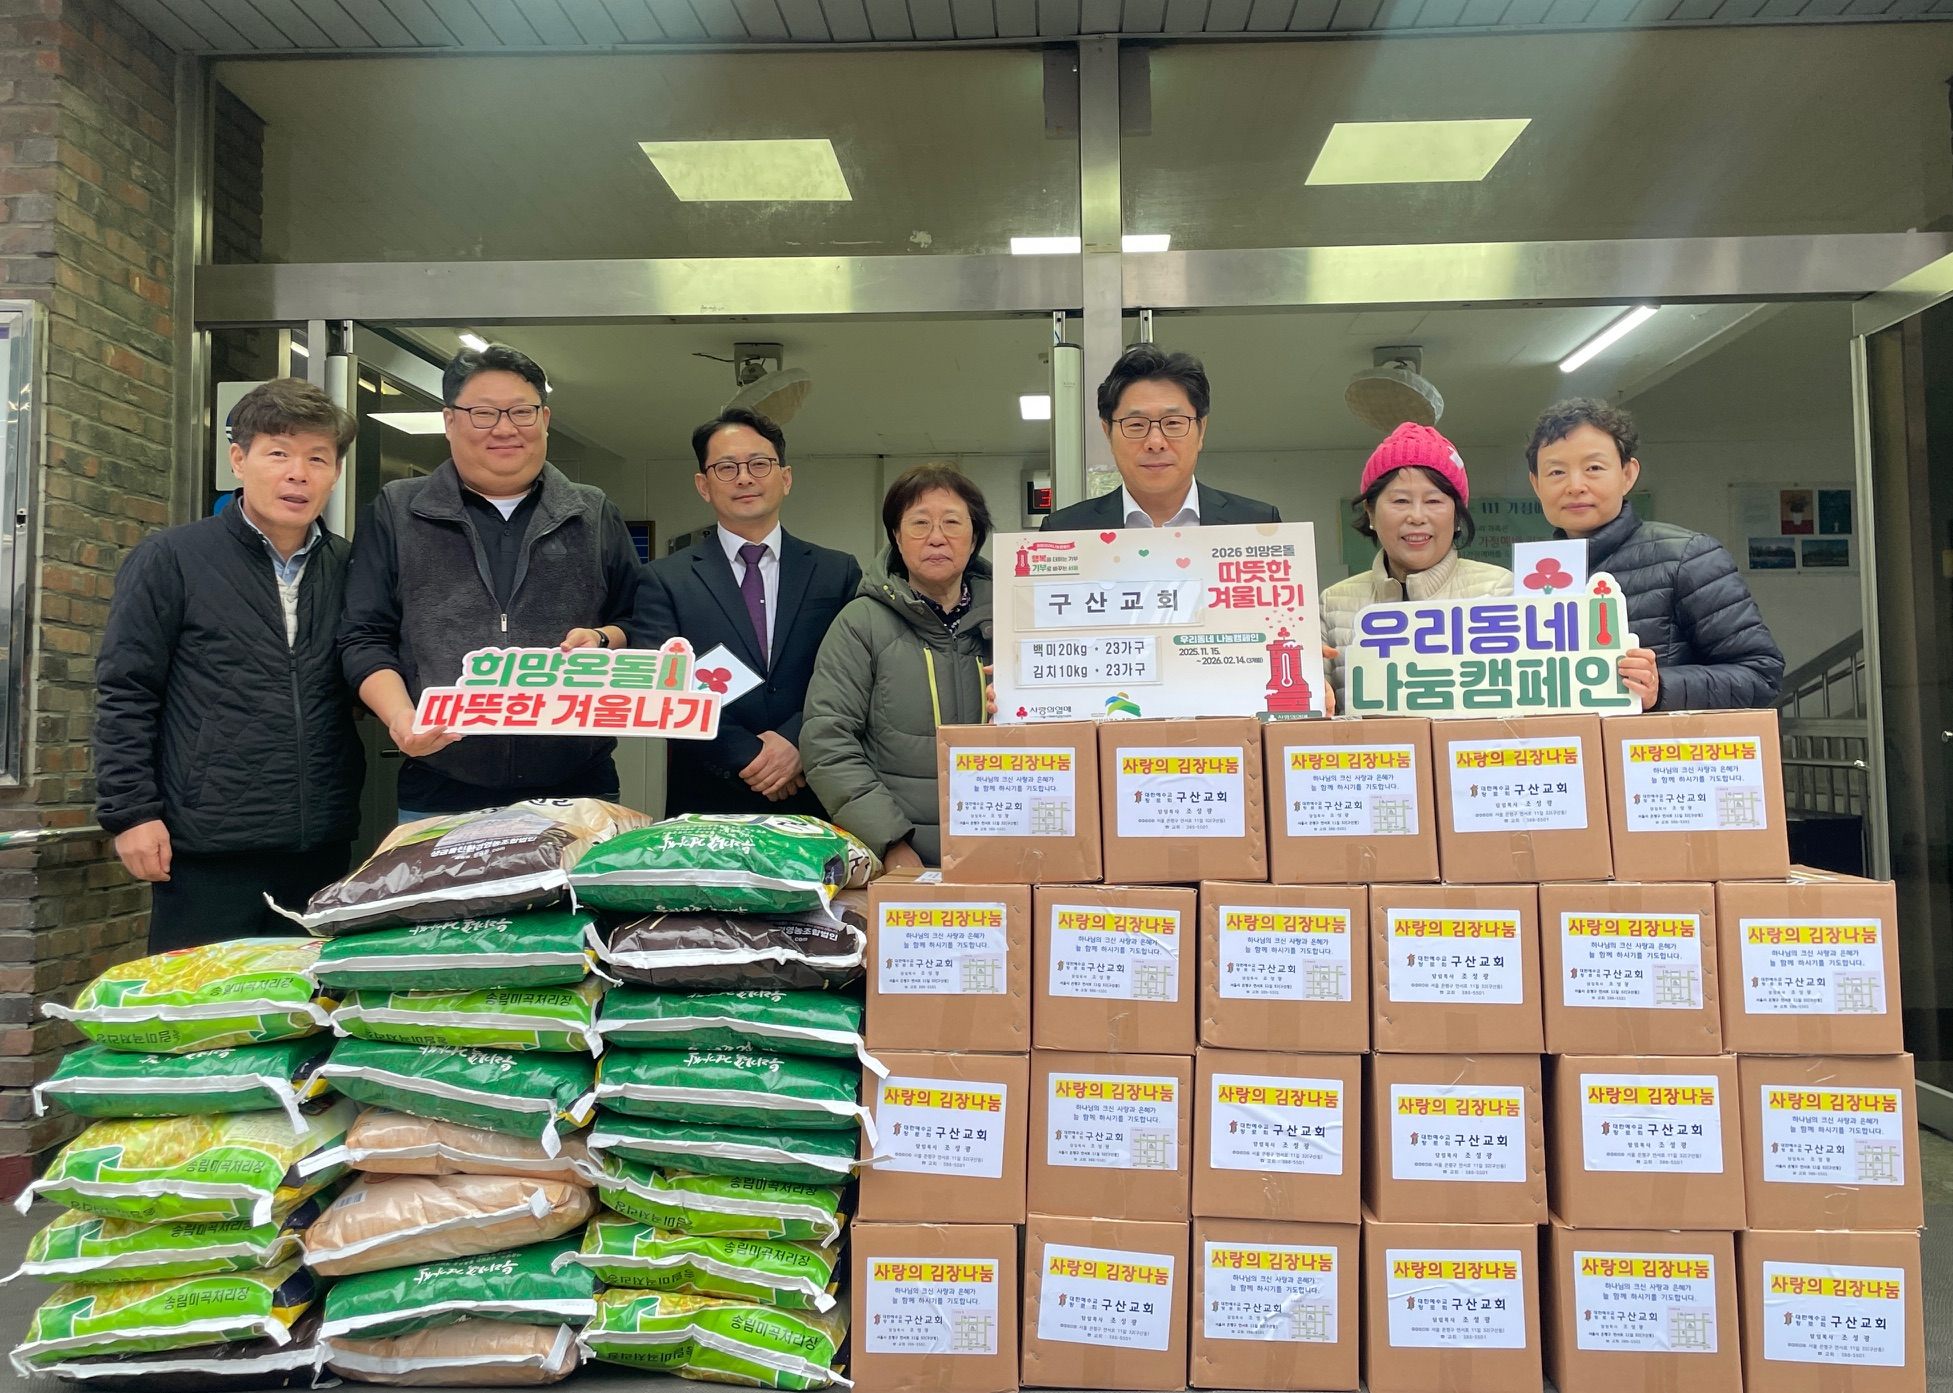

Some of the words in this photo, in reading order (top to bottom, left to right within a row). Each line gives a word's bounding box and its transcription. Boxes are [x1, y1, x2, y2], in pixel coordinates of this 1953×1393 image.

[1212, 547, 1242, 558] 2026
[1245, 544, 1295, 558] 희망온돌
[1218, 560, 1292, 584] 따뜻한
[1048, 590, 1179, 615] 구산교회
[1208, 584, 1305, 609] 겨울나기
[1360, 601, 1580, 658] 우리동네
[1180, 634, 1214, 644] 우리동네
[1216, 633, 1259, 643] 나눔캠페인
[1034, 643, 1088, 657] 백미20kg
[1106, 642, 1146, 655] 23가구
[1179, 648, 1200, 656] 2025.
[465, 652, 657, 689] 희망온돌
[1034, 664, 1088, 679] 김치10kg
[1106, 663, 1146, 677] 23가구
[1352, 654, 1632, 711] 나눔캠페인
[422, 693, 546, 726] 따뜻한
[552, 694, 712, 732] 겨울나기
[1291, 753, 1339, 769] 사랑의
[1347, 752, 1410, 769] 김장나눔
[1456, 751, 1504, 768] 사랑의
[1513, 748, 1578, 766] 김장나눔
[1630, 744, 1680, 762] 사랑의
[1688, 743, 1756, 760] 김장나눔
[956, 754, 1002, 770] 사랑의
[1009, 755, 1070, 771] 김장나눔
[1123, 758, 1168, 774] 사랑의
[1178, 758, 1239, 774] 김장나눔
[1652, 766, 1678, 774] 하나님의
[1697, 765, 1716, 773] 사랑과
[1678, 775, 1704, 783] 하시기를
[1709, 774, 1744, 782] 기도합니다.
[1513, 781, 1567, 795] 구산교회
[1176, 790, 1227, 803] 구산교회
[1665, 793, 1706, 803] 구산교회
[985, 801, 1022, 811] 구산교회
[1324, 800, 1362, 810] 구산교회
[886, 910, 932, 926] 사랑의
[940, 911, 1001, 927] 김장나눔
[1058, 912, 1105, 931] 사랑의
[1113, 915, 1175, 935] 김장나눔
[1227, 913, 1274, 931] 사랑의
[1282, 915, 1345, 933] 김장나눔
[1394, 920, 1442, 937] 사랑의
[1452, 921, 1516, 938] 김장나눔
[1569, 918, 1619, 936] 사랑의
[1627, 919, 1694, 937] 김장나눔
[1748, 927, 1800, 943] 사랑의
[1808, 927, 1877, 944] 김장나눔
[915, 958, 953, 968] 구산교회
[1086, 962, 1124, 973] 구산교회
[1257, 963, 1295, 974] 구산교회
[1450, 955, 1504, 968] 구산교회
[1602, 968, 1643, 979] 구산교회
[1784, 977, 1825, 987] 구산교회
[485, 992, 572, 1006] 송림미곡처리장
[1055, 1080, 1103, 1099] 사랑의
[1110, 1083, 1173, 1102] 김장나눔
[1218, 1086, 1265, 1105] 사랑의
[1275, 1089, 1338, 1108] 김장나눔
[1587, 1087, 1638, 1104] 사랑의
[1647, 1087, 1714, 1105] 김장나눔
[884, 1088, 930, 1107] 사랑의
[939, 1091, 1002, 1112] 김장나눔
[1397, 1098, 1446, 1115] 사랑의
[1456, 1099, 1519, 1116] 김장나눔
[1769, 1091, 1821, 1110] 사랑의
[1829, 1093, 1896, 1113] 김장나눔
[935, 1125, 987, 1141] 구산교회
[1085, 1131, 1123, 1142] 구산교회
[1272, 1123, 1325, 1138] 구산교회
[1647, 1122, 1702, 1136] 구산교회
[1454, 1133, 1507, 1147] 구산교회
[1804, 1143, 1845, 1154] 구산교회
[186, 1158, 266, 1174] 송림미곡처리장
[730, 1176, 817, 1196] 송림미곡처리장
[724, 1240, 811, 1267] 송림미곡처리장
[1212, 1250, 1260, 1269] 사랑의
[1268, 1252, 1332, 1272] 김장나눔
[874, 1263, 922, 1281] 사랑의
[930, 1264, 993, 1282] 김장나눔
[1049, 1258, 1097, 1279] 사랑의
[1105, 1263, 1169, 1285] 김장나눔
[1393, 1261, 1442, 1279] 사랑의
[1452, 1262, 1517, 1279] 김장나눔
[1582, 1258, 1633, 1277] 사랑의
[1641, 1260, 1709, 1279] 김장나눔
[1604, 1282, 1630, 1290] 하나님의
[1649, 1283, 1669, 1291] 사랑과
[1771, 1276, 1822, 1295] 사랑의
[1832, 1279, 1900, 1299] 김장나눔
[164, 1286, 250, 1310] 송림미곡처리장
[1451, 1297, 1505, 1310] 구산교회
[1630, 1293, 1656, 1301] 하시기를
[1661, 1293, 1696, 1302] 기도합니다.
[1101, 1297, 1154, 1315] 구산교회
[1242, 1302, 1281, 1313] 구산교회
[904, 1314, 942, 1325] 구산교회
[1616, 1310, 1657, 1322] 구산교회
[1830, 1314, 1886, 1330] 구산교회
[731, 1314, 818, 1351] 송림미곡처리장
